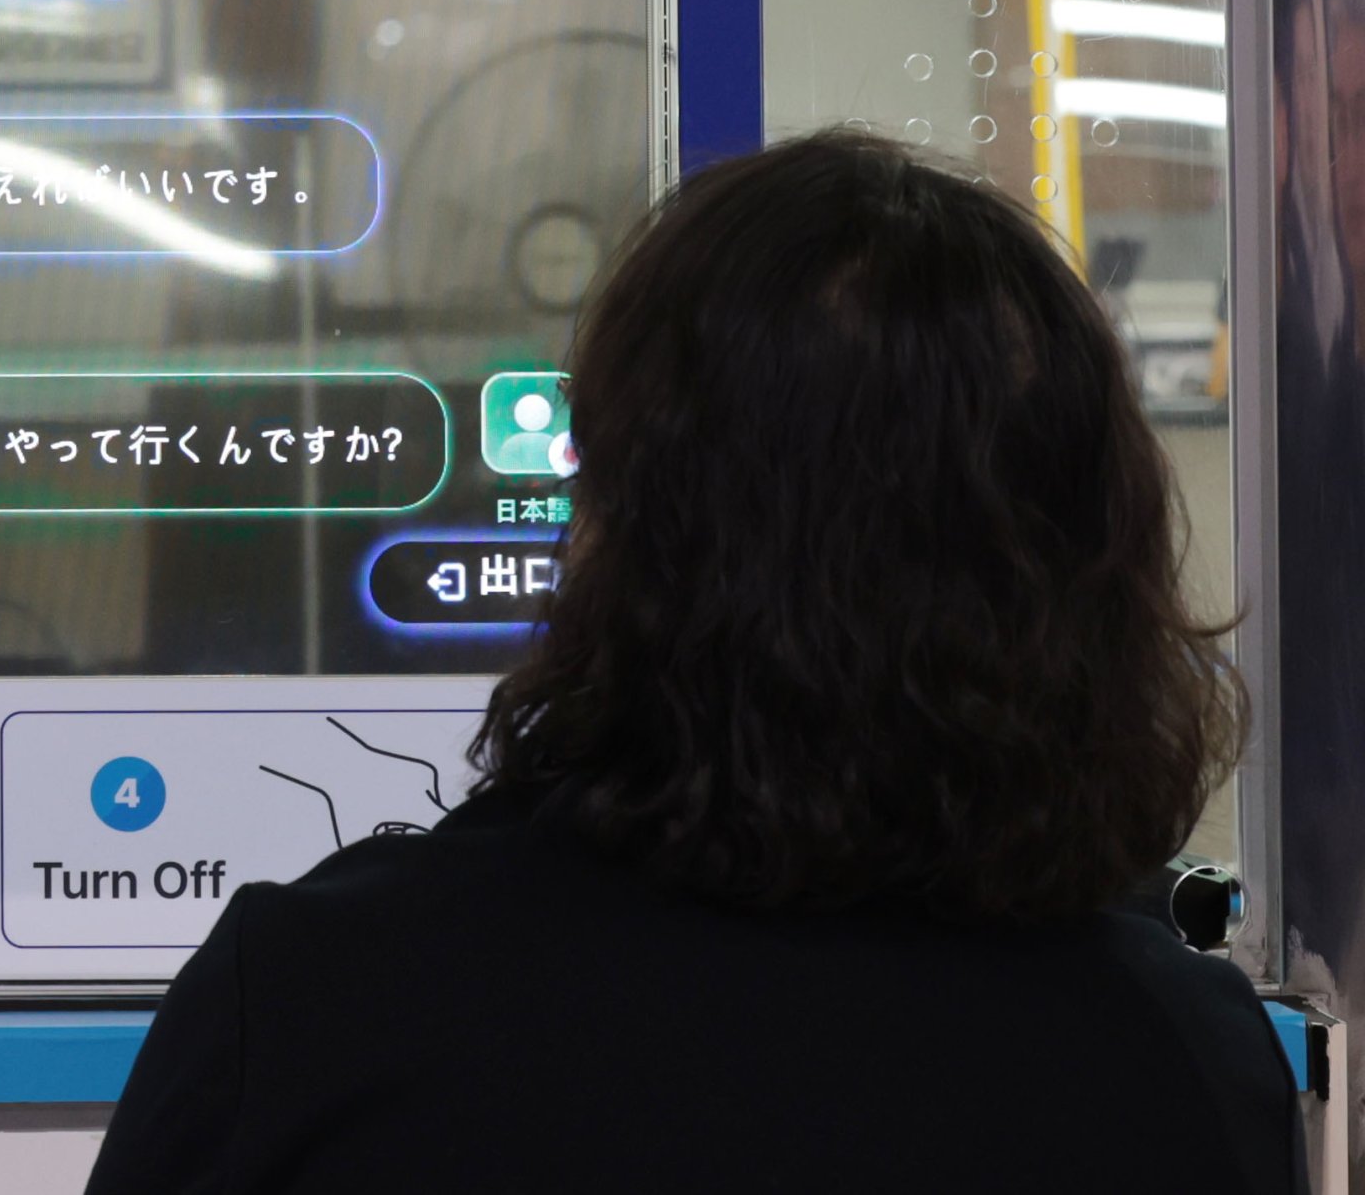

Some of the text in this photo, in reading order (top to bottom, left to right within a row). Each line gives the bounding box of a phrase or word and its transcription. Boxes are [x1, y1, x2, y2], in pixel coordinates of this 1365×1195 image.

[115, 778, 139, 807] 4
[33, 860, 227, 899] Turn Off
